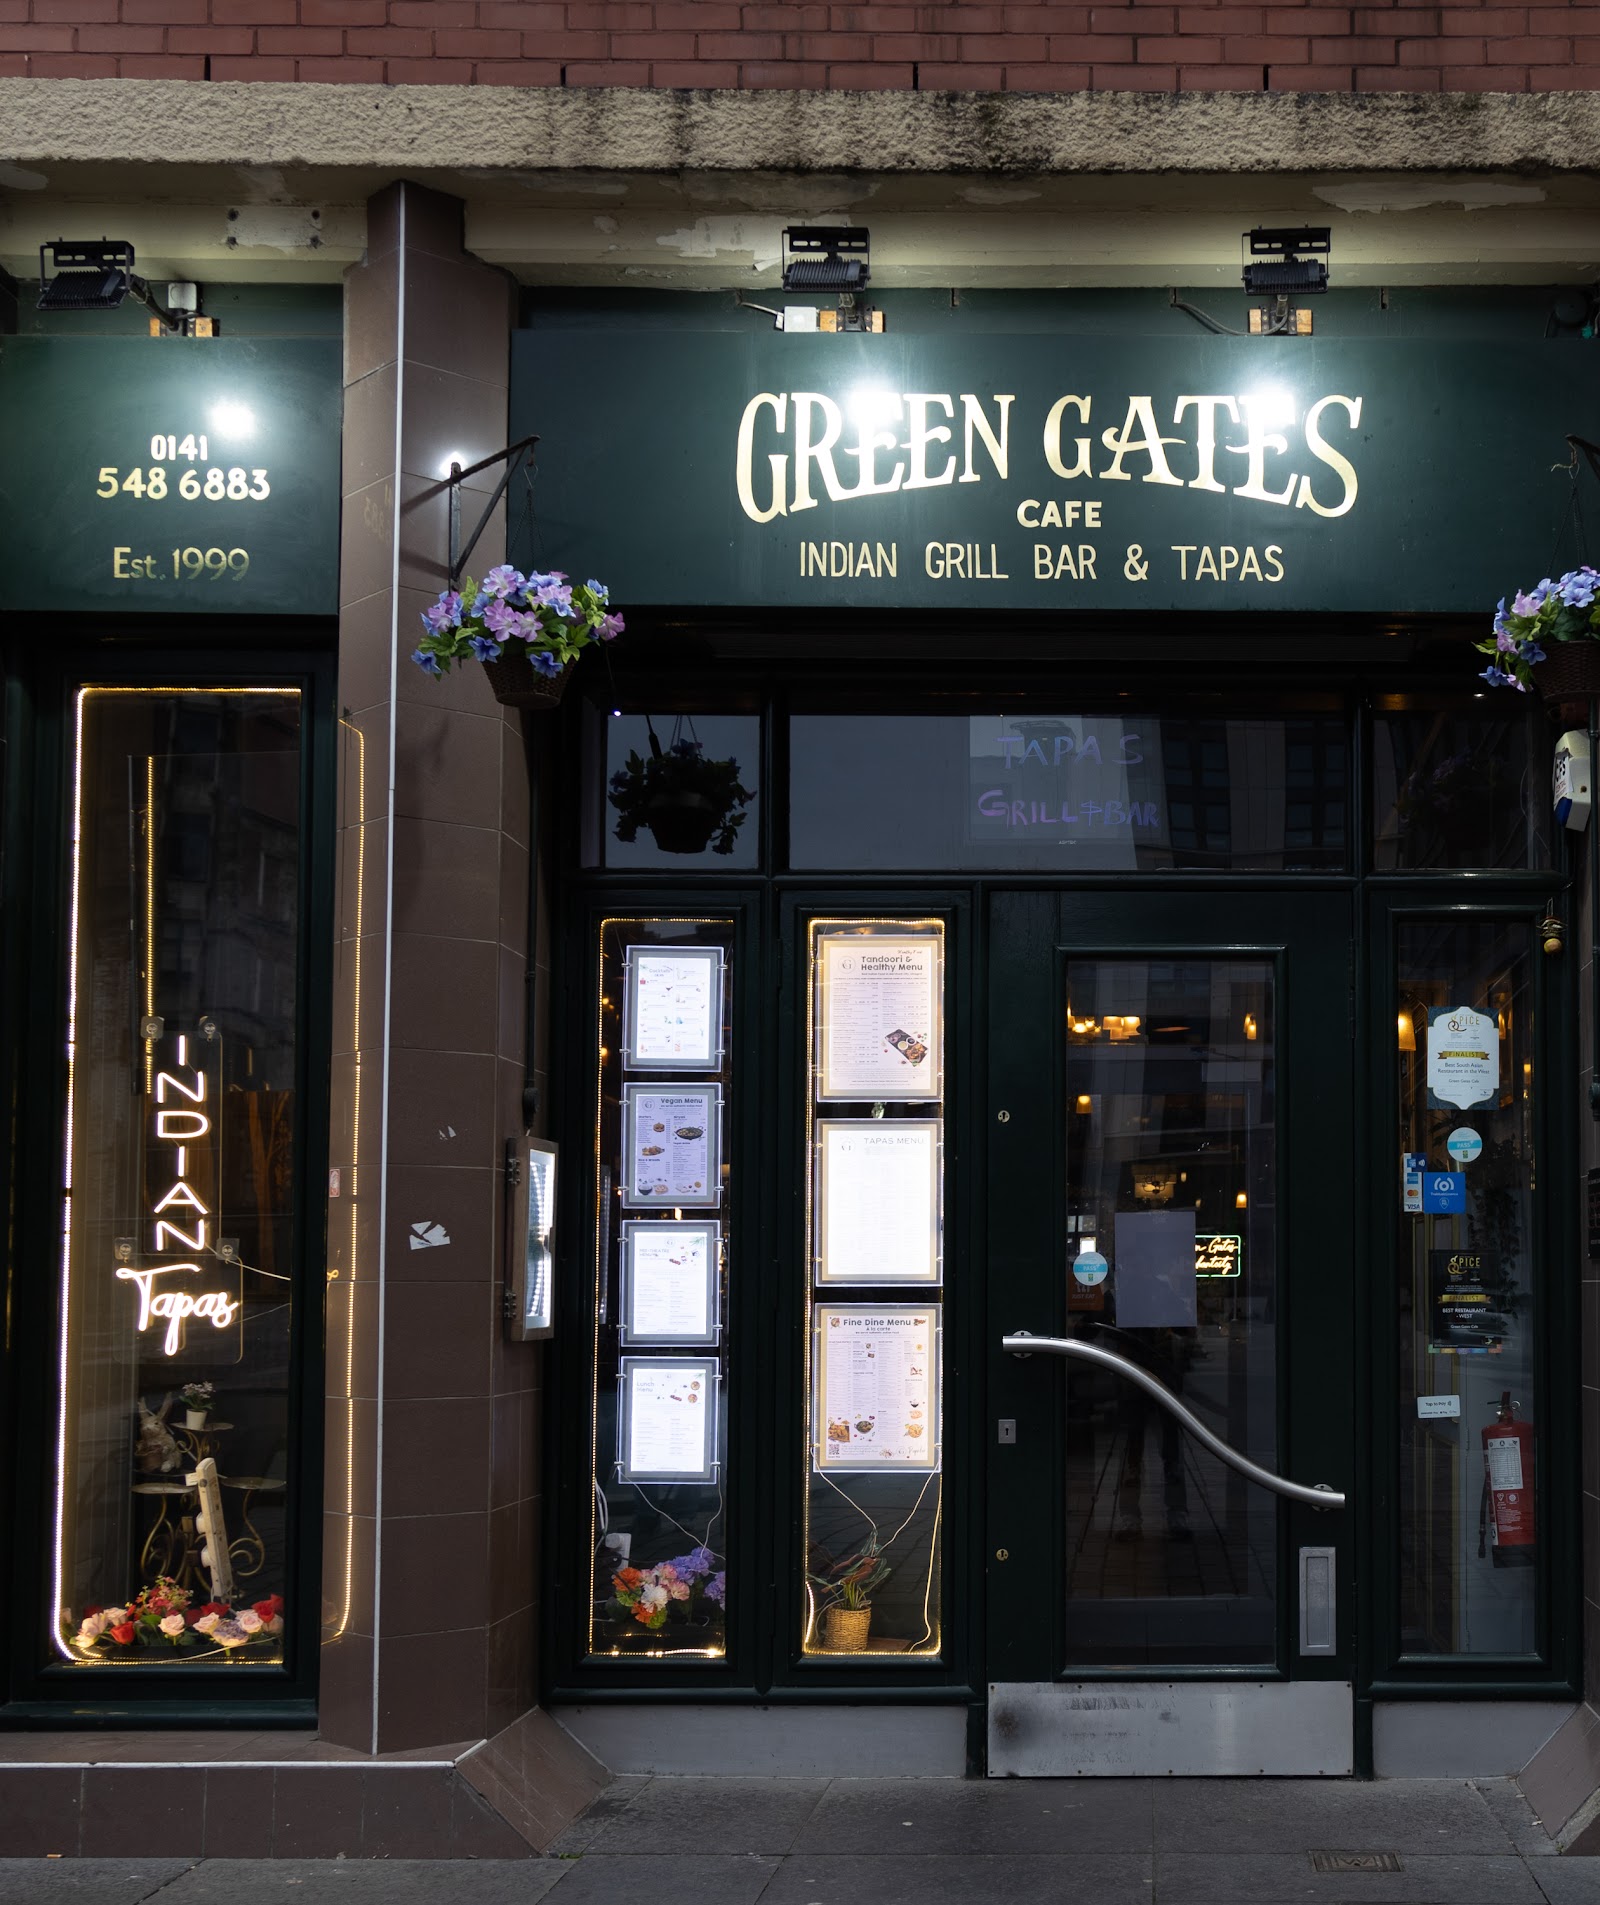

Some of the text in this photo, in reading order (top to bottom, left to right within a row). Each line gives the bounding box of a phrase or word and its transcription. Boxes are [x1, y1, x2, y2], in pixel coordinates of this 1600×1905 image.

[151, 434, 208, 461] 0141
[736, 392, 1362, 523] GREEN GATES
[96, 467, 271, 501] 548 6883
[1017, 499, 1102, 528] CAFE
[113, 547, 250, 581] Est. 1999
[800, 541, 1285, 582] INDIAN GRILL BAR & TAPAS
[861, 955, 903, 963] Tandoori
[861, 963, 923, 972] Healthy Menu
[154, 1035, 209, 1251] INDIAN
[116, 1263, 239, 1356] Tapas
[843, 1318, 911, 1326] Fine Dine Menu
